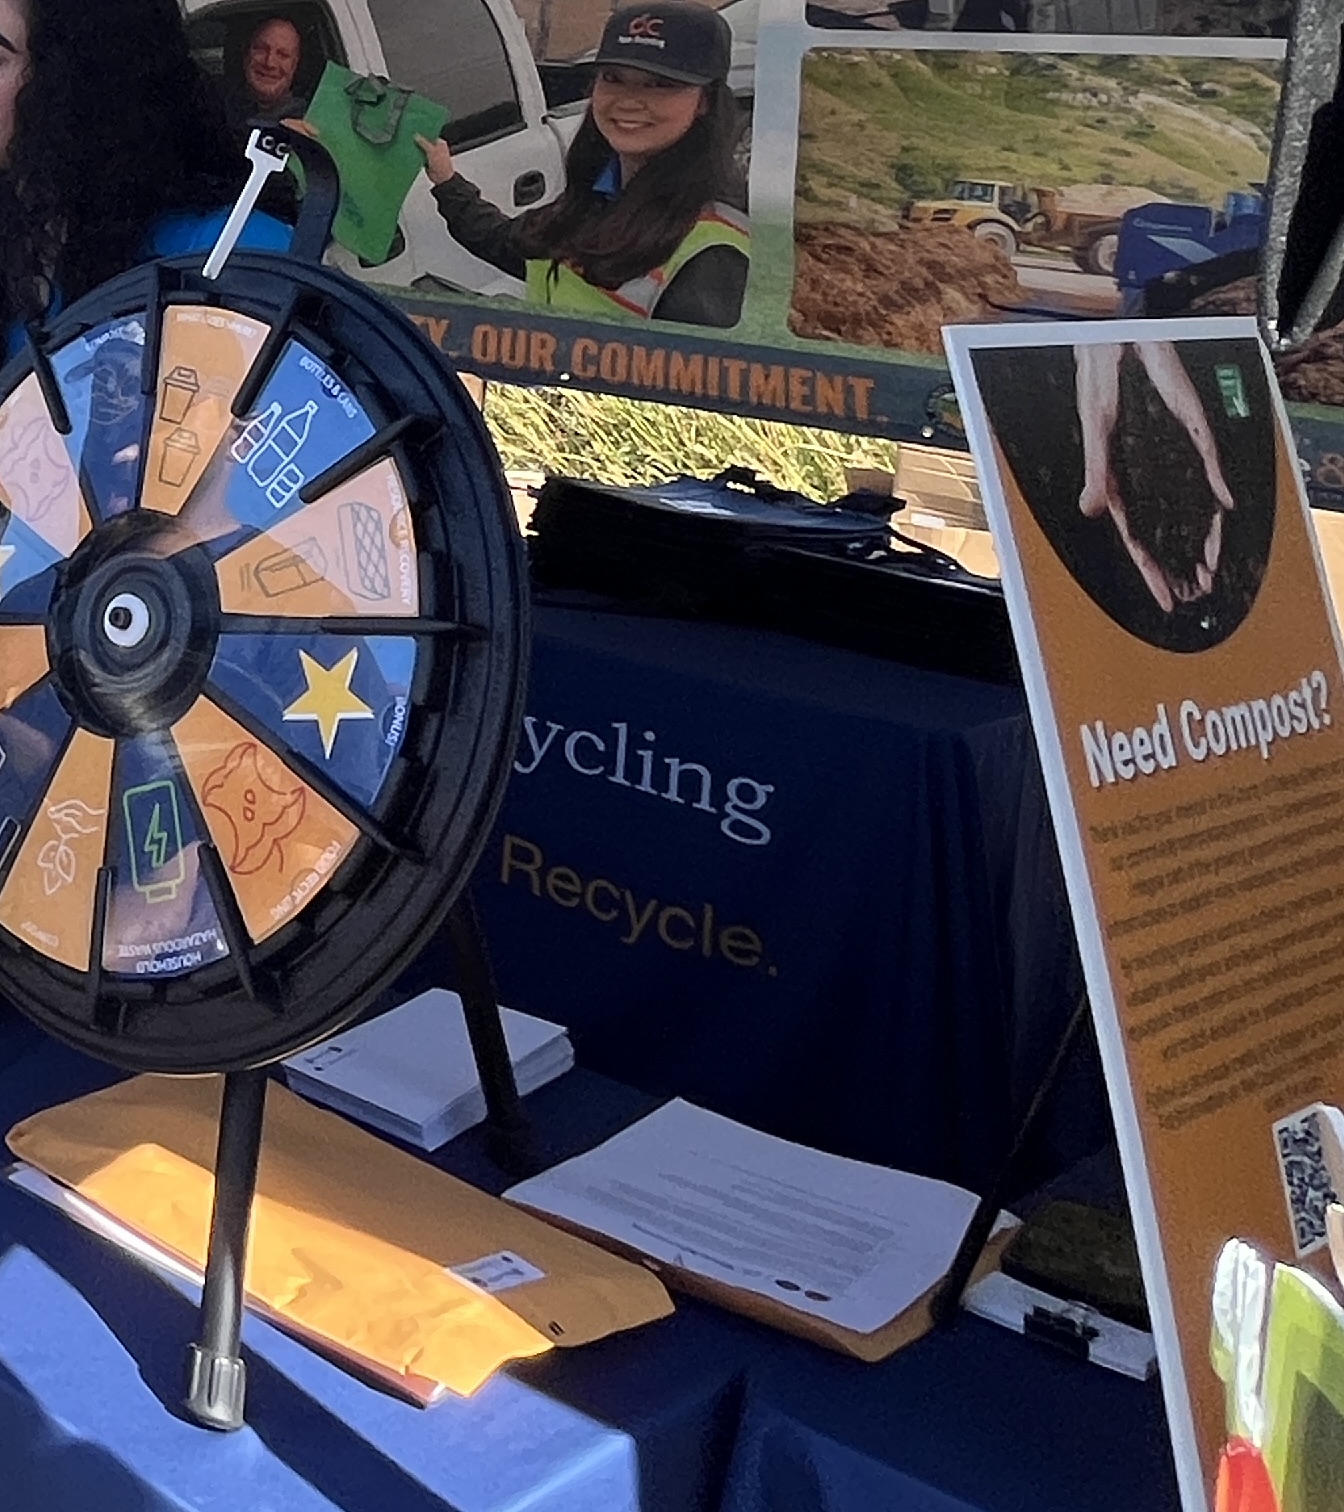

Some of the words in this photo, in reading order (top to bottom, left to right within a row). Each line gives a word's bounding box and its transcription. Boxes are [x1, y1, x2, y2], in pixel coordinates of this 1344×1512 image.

[471, 323, 557, 374] OUR
[570, 337, 889, 424] COMMITMENT.
[513, 714, 775, 846] ycling
[1079, 702, 1178, 790] Need
[1179, 669, 1332, 761] Compost?
[499, 833, 779, 978] Recycle.
